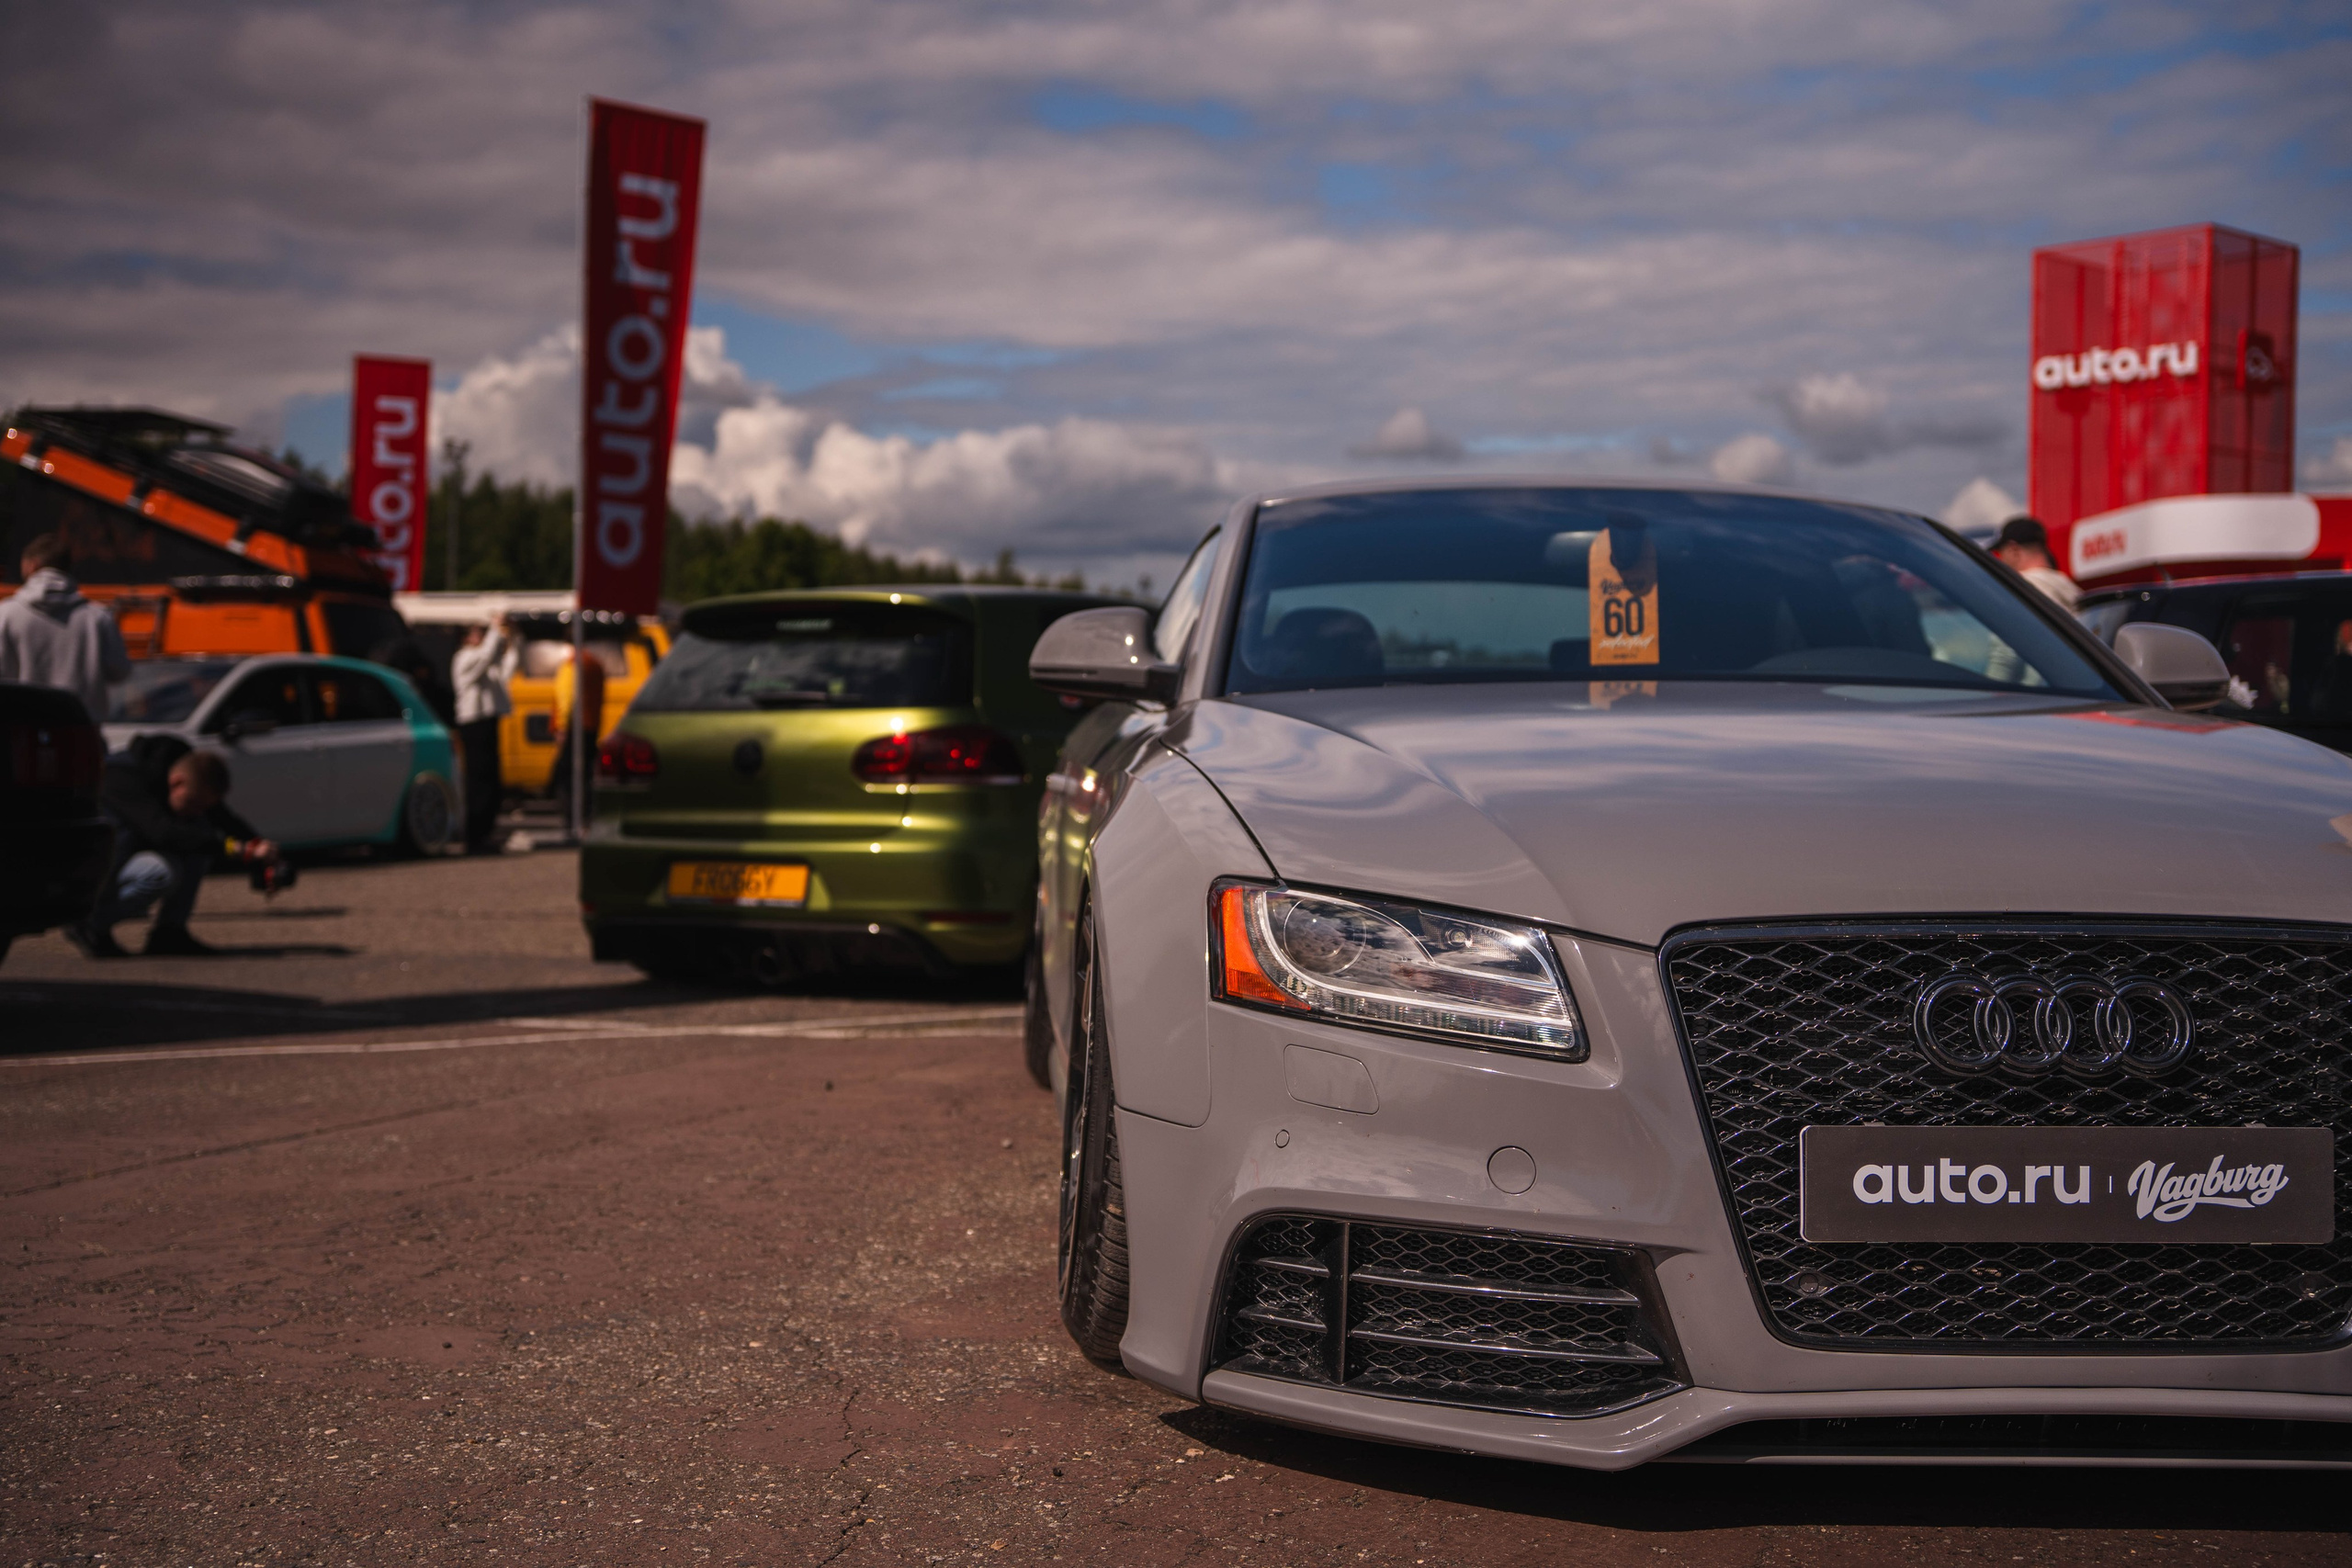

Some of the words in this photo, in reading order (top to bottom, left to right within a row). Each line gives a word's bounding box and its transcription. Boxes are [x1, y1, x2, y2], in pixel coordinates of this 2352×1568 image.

[595, 172, 679, 567] auto.ru
[2033, 340, 2199, 389] auto.ru
[1604, 598, 1645, 637] 60
[1852, 1157, 2091, 1204] auto.ru
[2127, 1154, 2290, 1223] Vagburg
